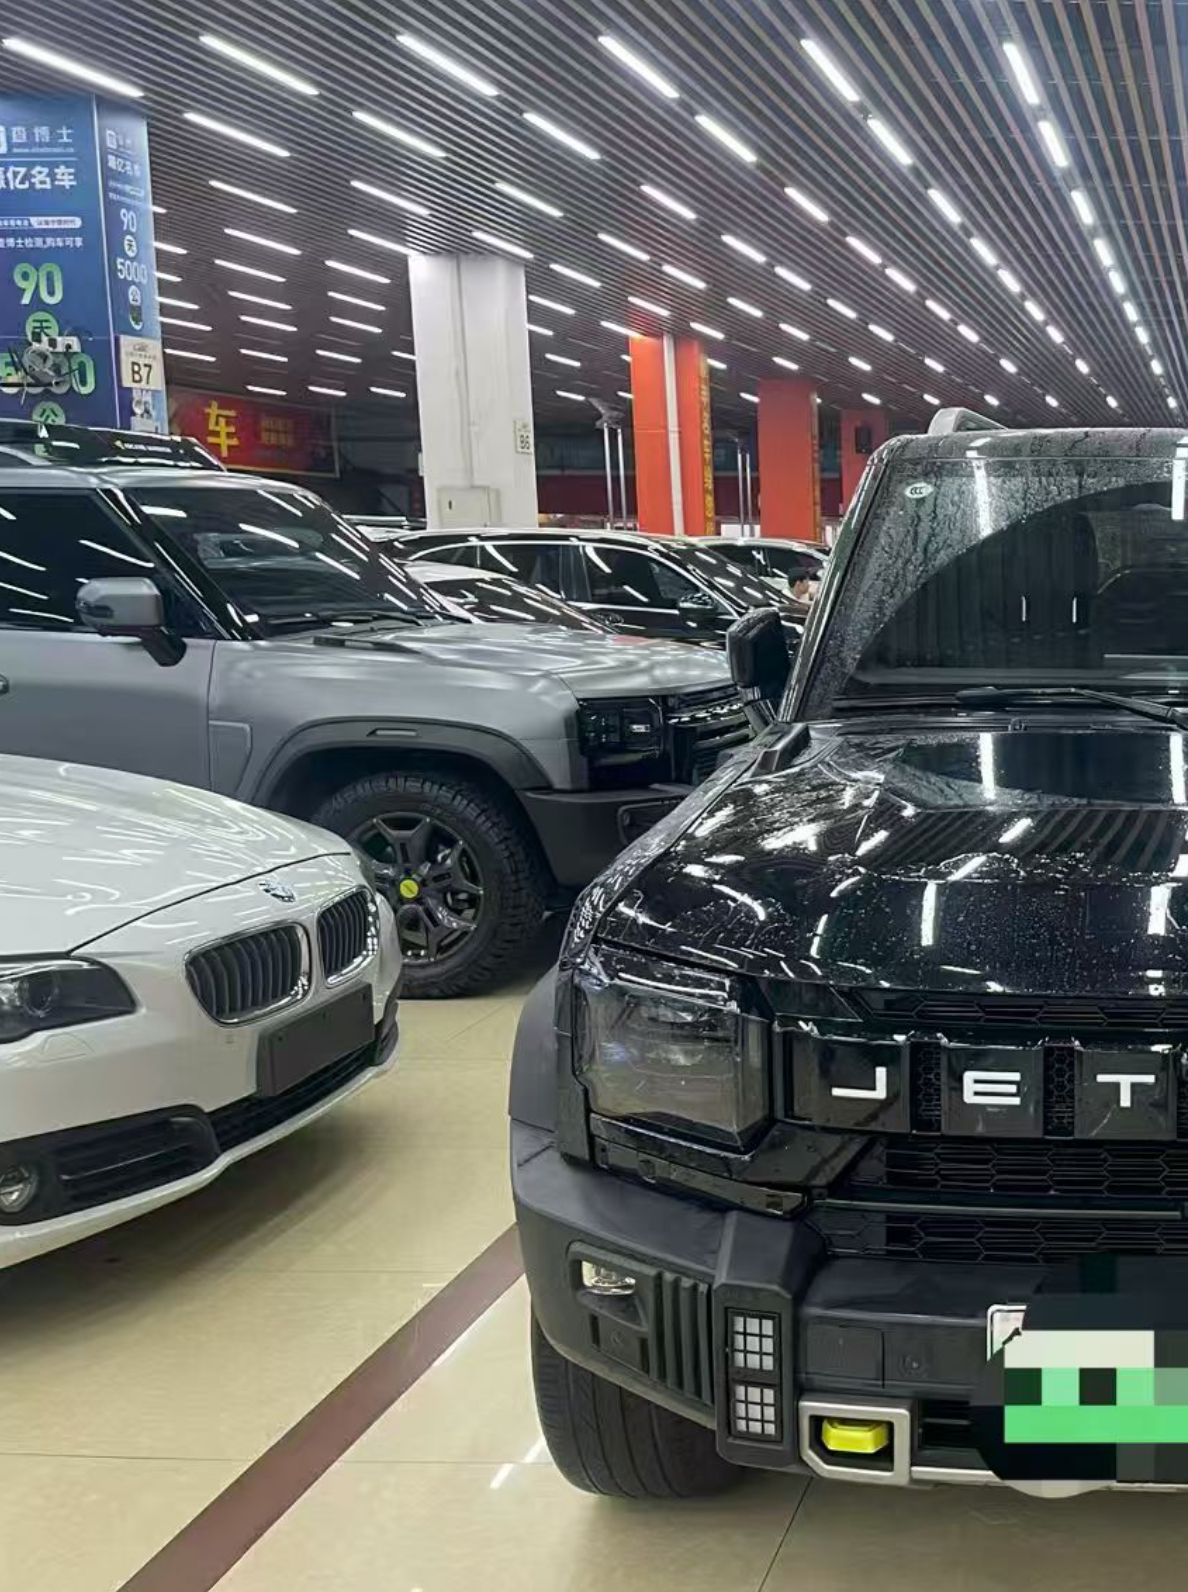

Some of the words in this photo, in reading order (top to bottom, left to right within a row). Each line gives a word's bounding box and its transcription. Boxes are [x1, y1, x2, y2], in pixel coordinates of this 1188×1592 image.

[120, 208, 137, 232] 90
[13, 263, 63, 304] 90
[116, 258, 147, 284] 5000
[0, 353, 95, 394] 50
[131, 361, 153, 386] B7
[204, 400, 240, 458] 车
